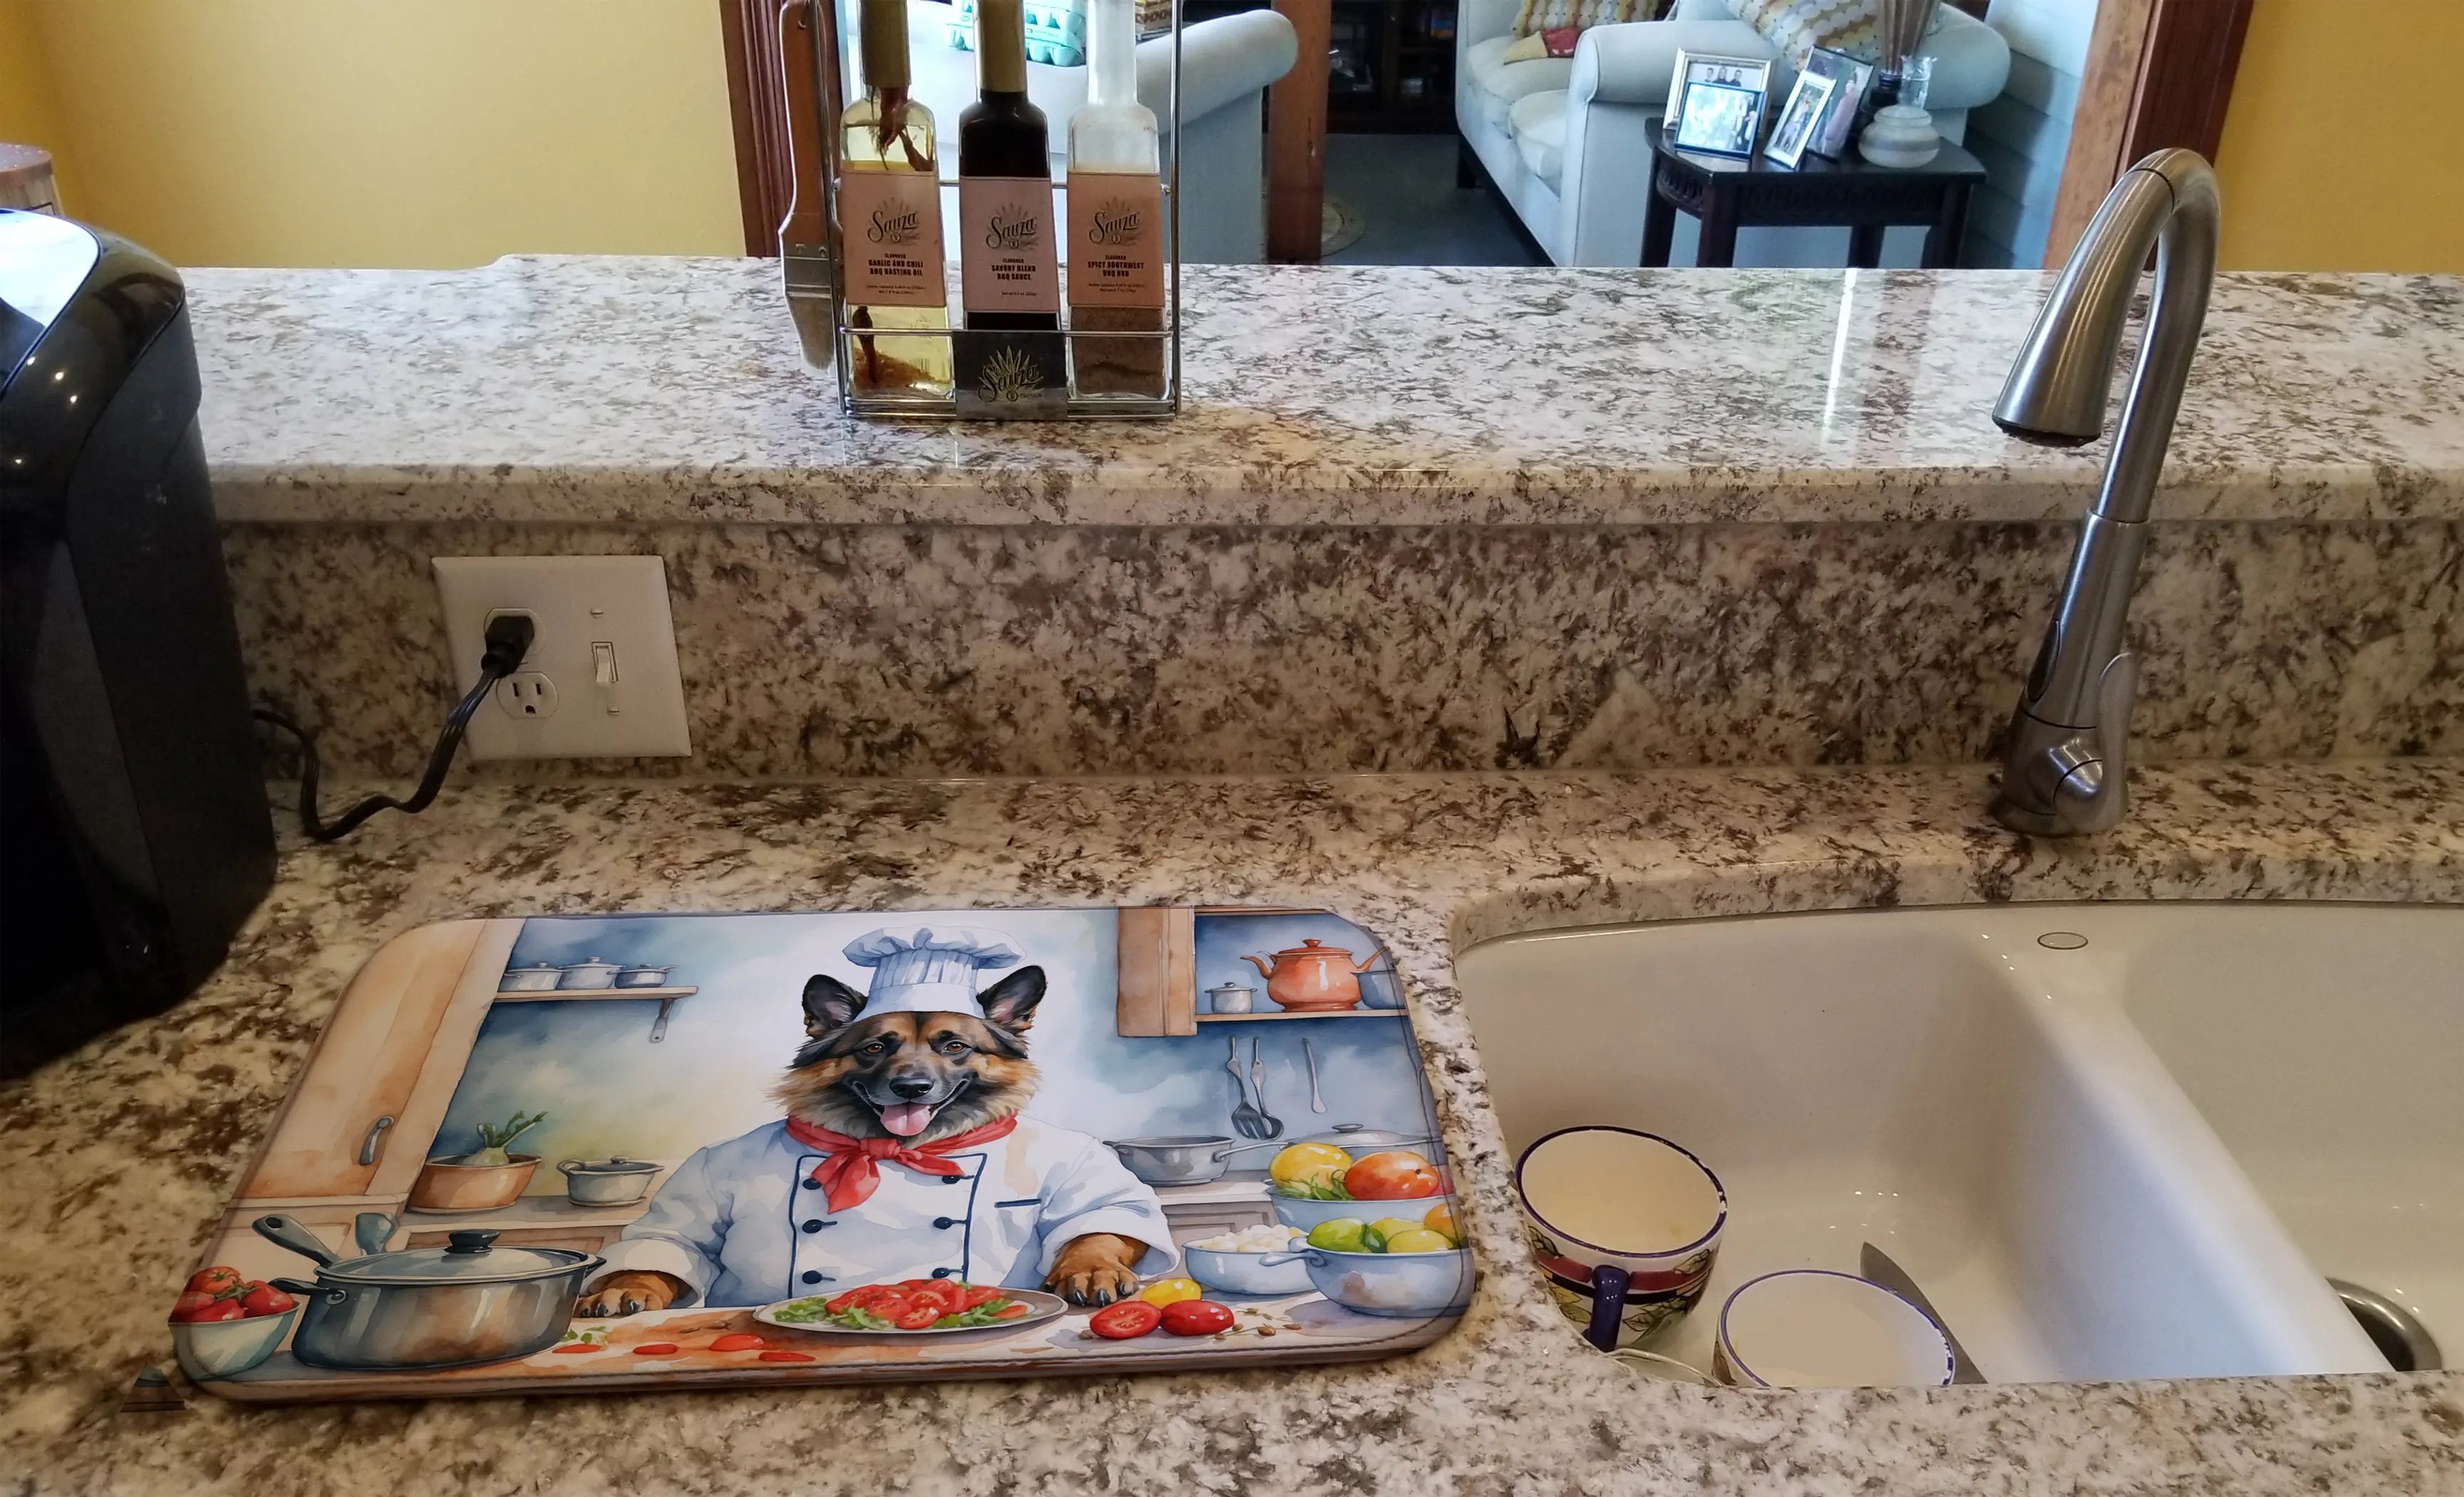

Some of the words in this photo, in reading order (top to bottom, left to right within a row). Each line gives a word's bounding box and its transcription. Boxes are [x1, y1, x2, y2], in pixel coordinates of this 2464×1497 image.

[867, 210, 919, 243] Sauza
[986, 216, 1037, 249] Sauza
[1089, 210, 1140, 244] Sauza
[978, 364, 1038, 403] Sauza
